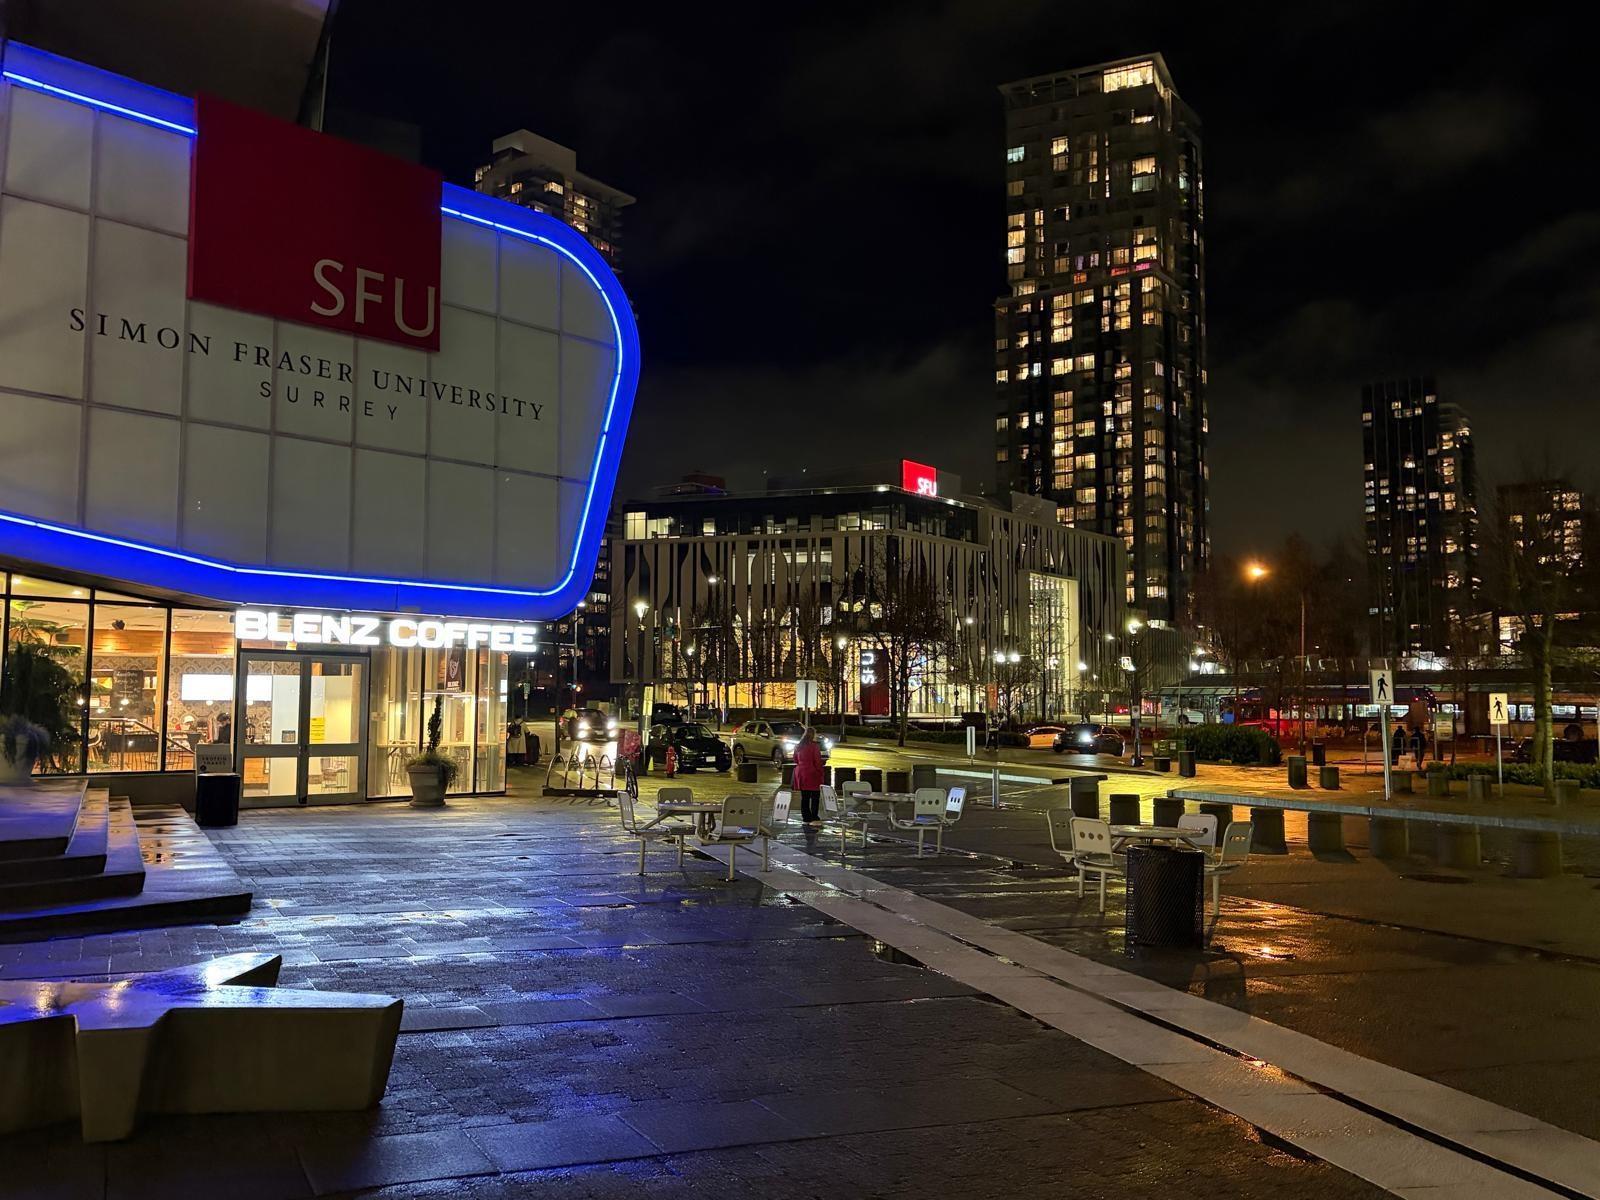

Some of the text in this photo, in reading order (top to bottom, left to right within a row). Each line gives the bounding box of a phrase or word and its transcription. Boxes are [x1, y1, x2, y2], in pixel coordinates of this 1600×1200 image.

[310, 258, 435, 338] SFU
[69, 308, 544, 421] SIMON FRASER UNIVERSITY
[260, 381, 398, 421] SURREY
[917, 477, 937, 497] SFU
[235, 610, 537, 653] BLENZ COFFEE
[861, 652, 875, 684] SFU
